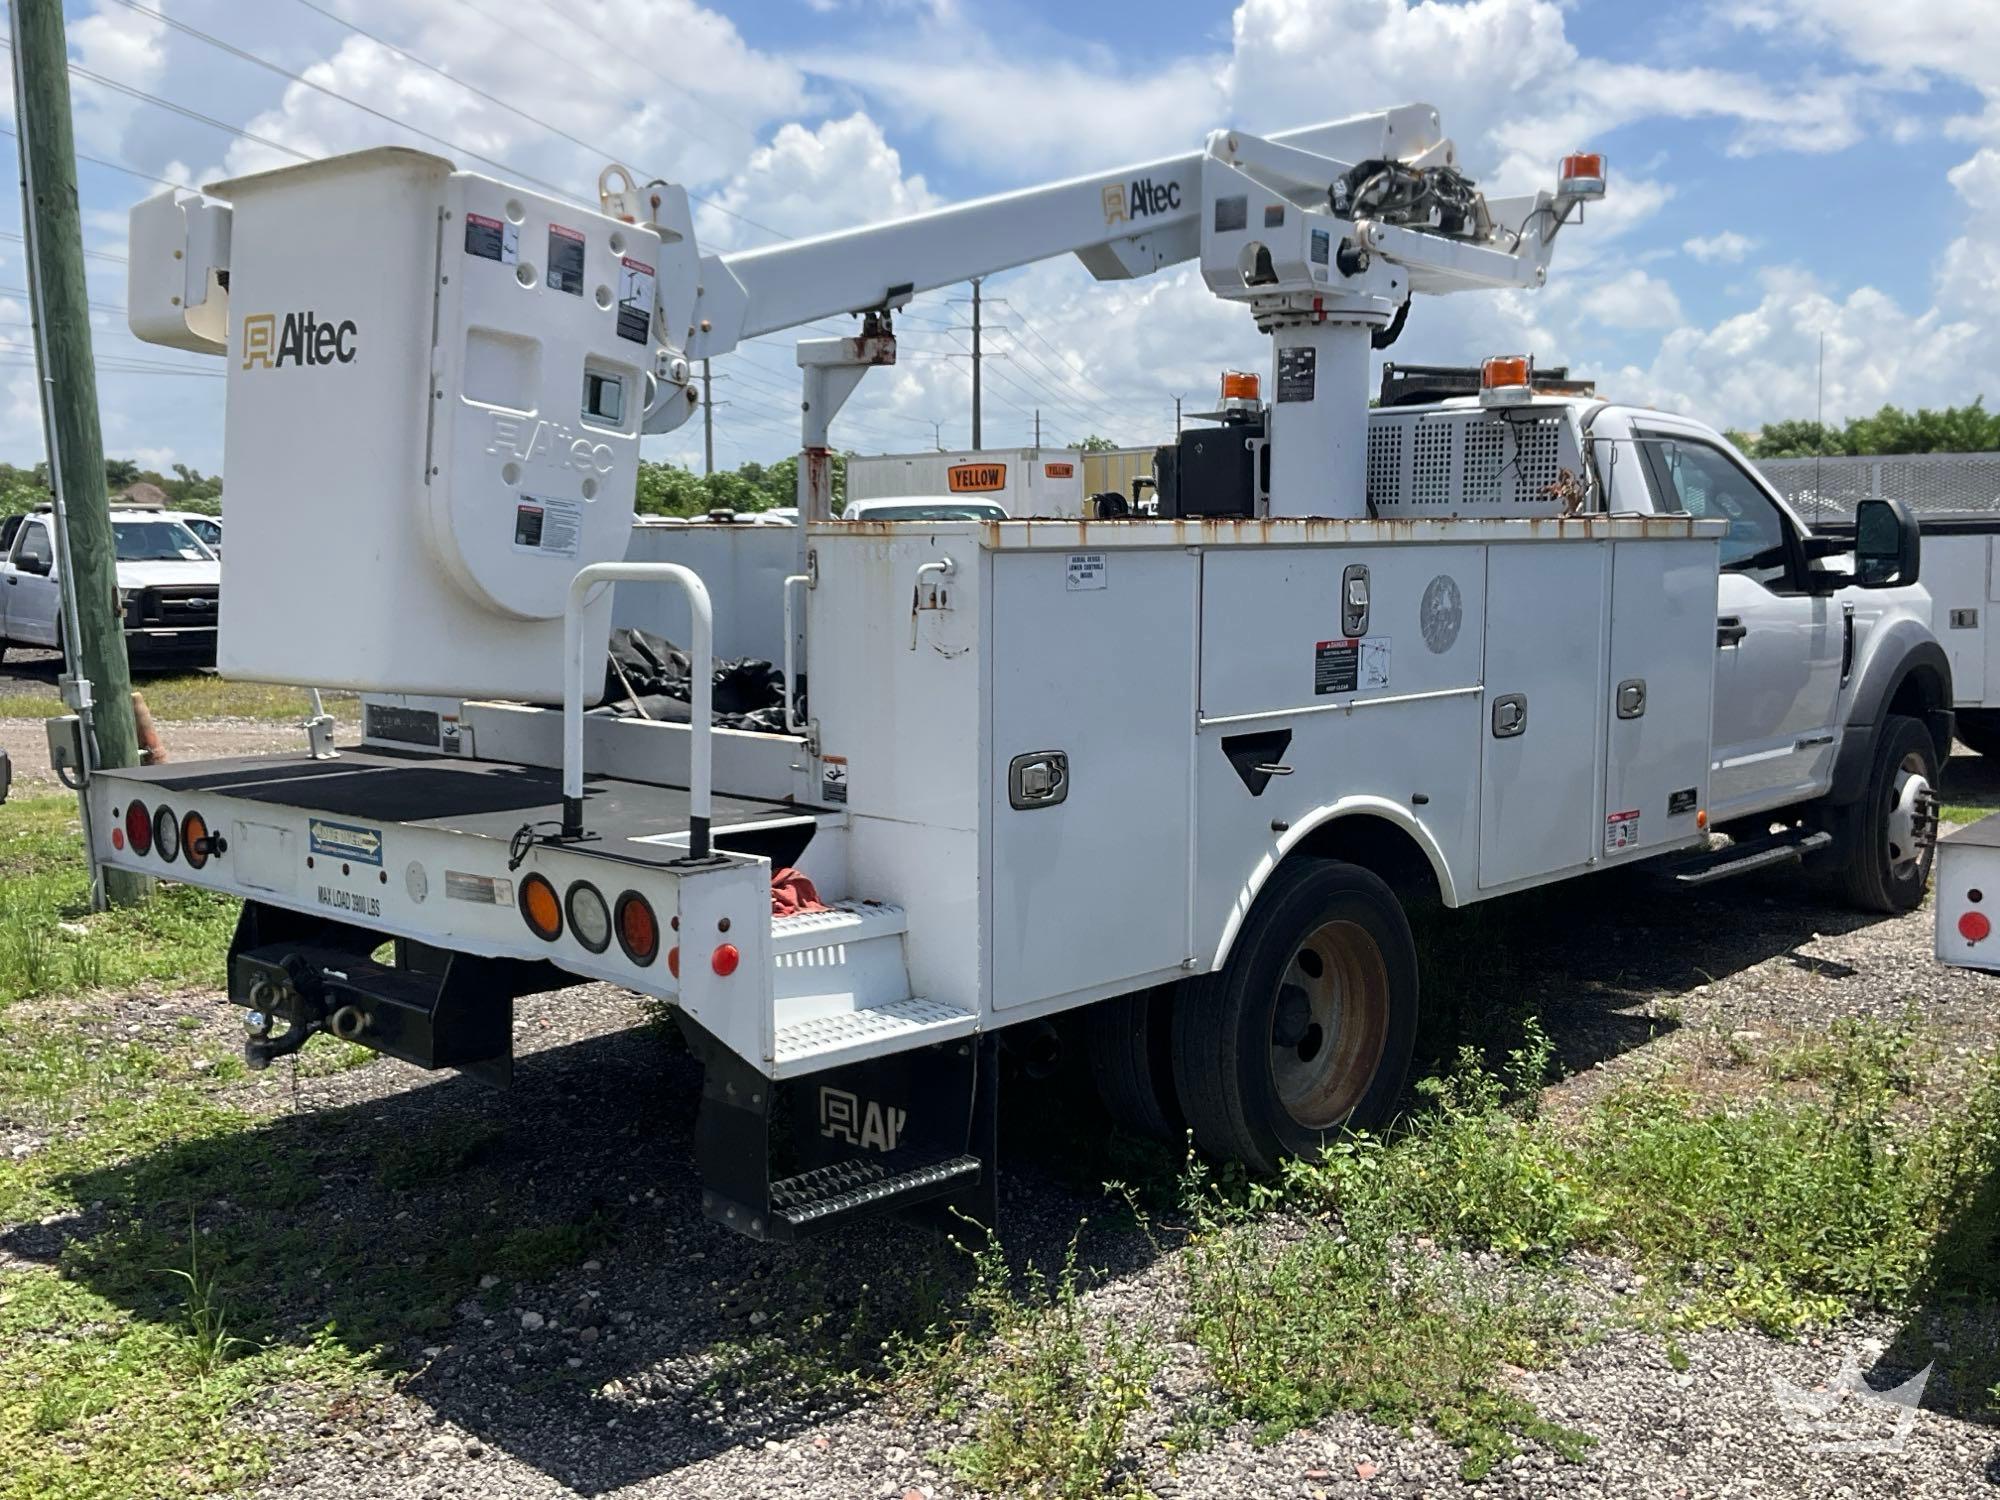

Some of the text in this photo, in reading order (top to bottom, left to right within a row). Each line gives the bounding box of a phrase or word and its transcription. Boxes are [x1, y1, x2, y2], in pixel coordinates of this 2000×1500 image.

[1130, 178, 1181, 220] Altec
[275, 311, 357, 368] Altec
[525, 420, 614, 473] Altec
[955, 469, 998, 487] YELLOW
[1049, 466, 1070, 475] YELLOW
[318, 886, 332, 906] MAX
[333, 889, 350, 910] LOAD
[367, 896, 380, 917] LBS
